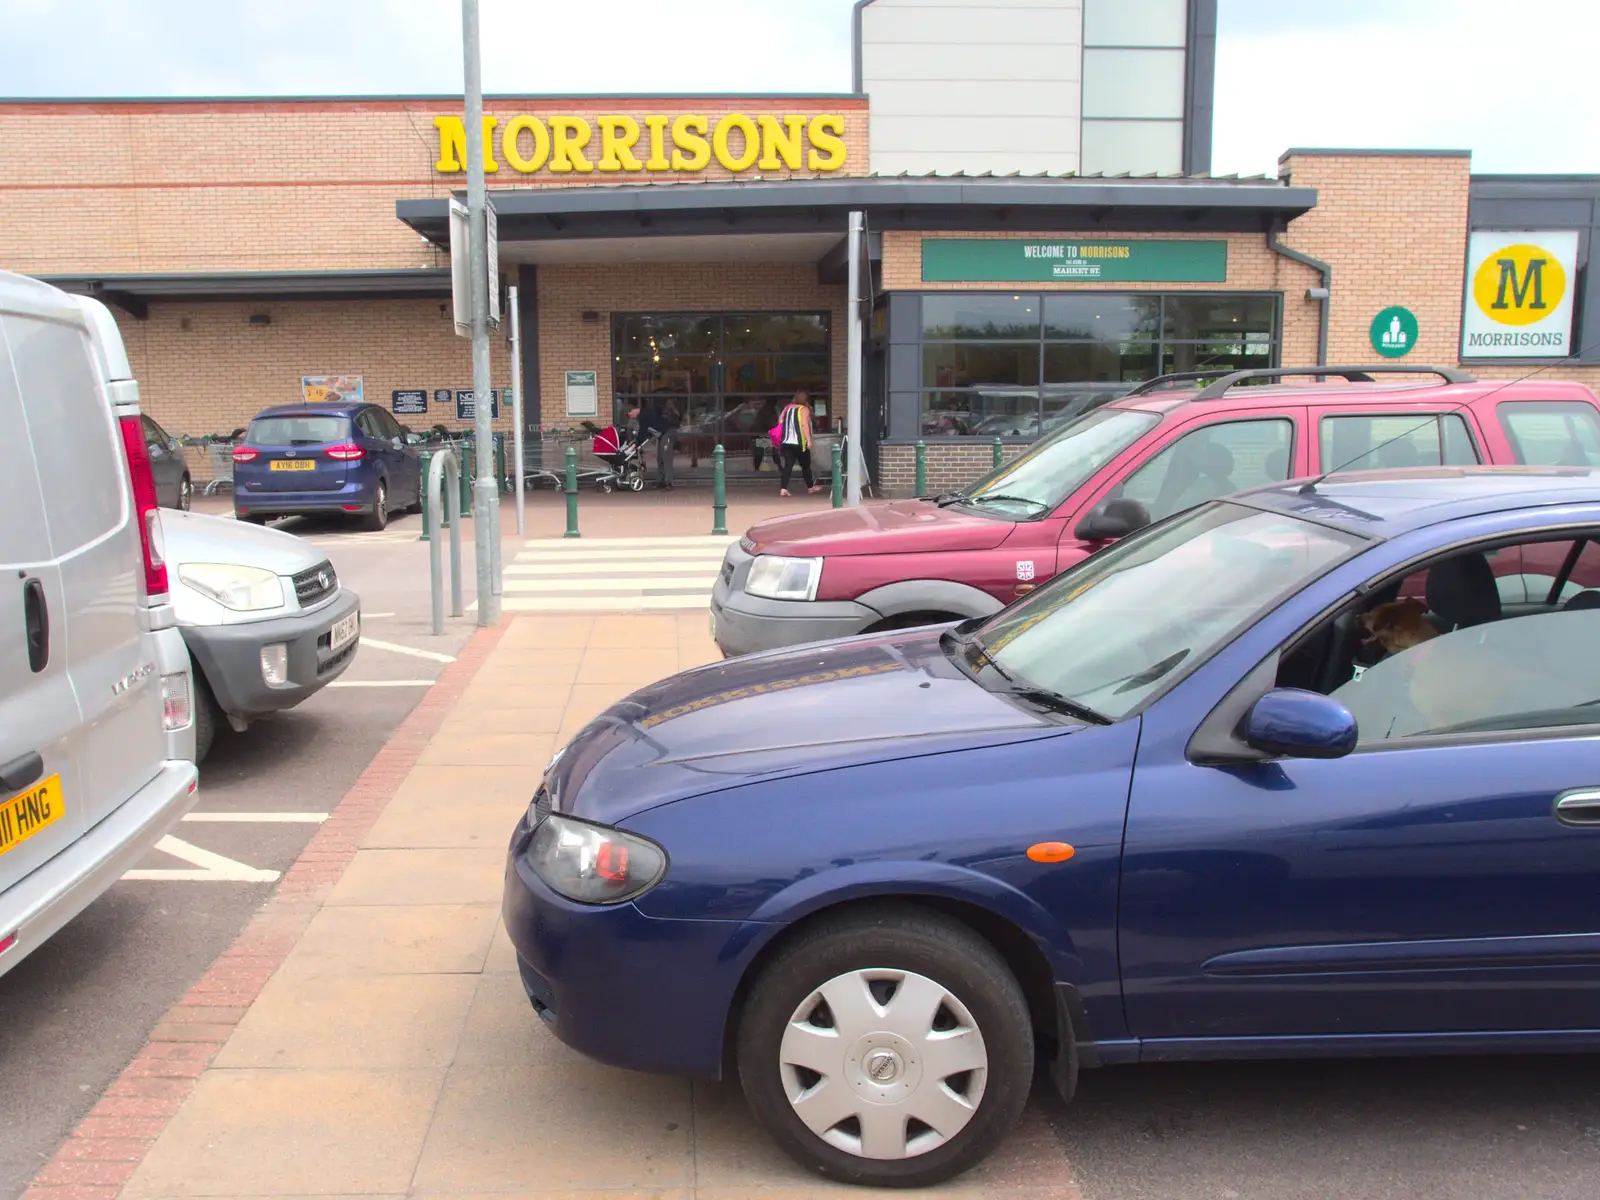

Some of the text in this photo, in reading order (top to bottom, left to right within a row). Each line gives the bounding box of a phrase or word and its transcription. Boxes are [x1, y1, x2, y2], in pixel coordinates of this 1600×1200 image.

[434, 113, 847, 173] MORRISONS
[1024, 245, 1130, 258] WELCOME TO MORRISONS
[1053, 267, 1089, 275] MARKET
[1491, 259, 1547, 310] M
[1468, 332, 1563, 347] MORRISONS
[15, 787, 50, 836] HNG
